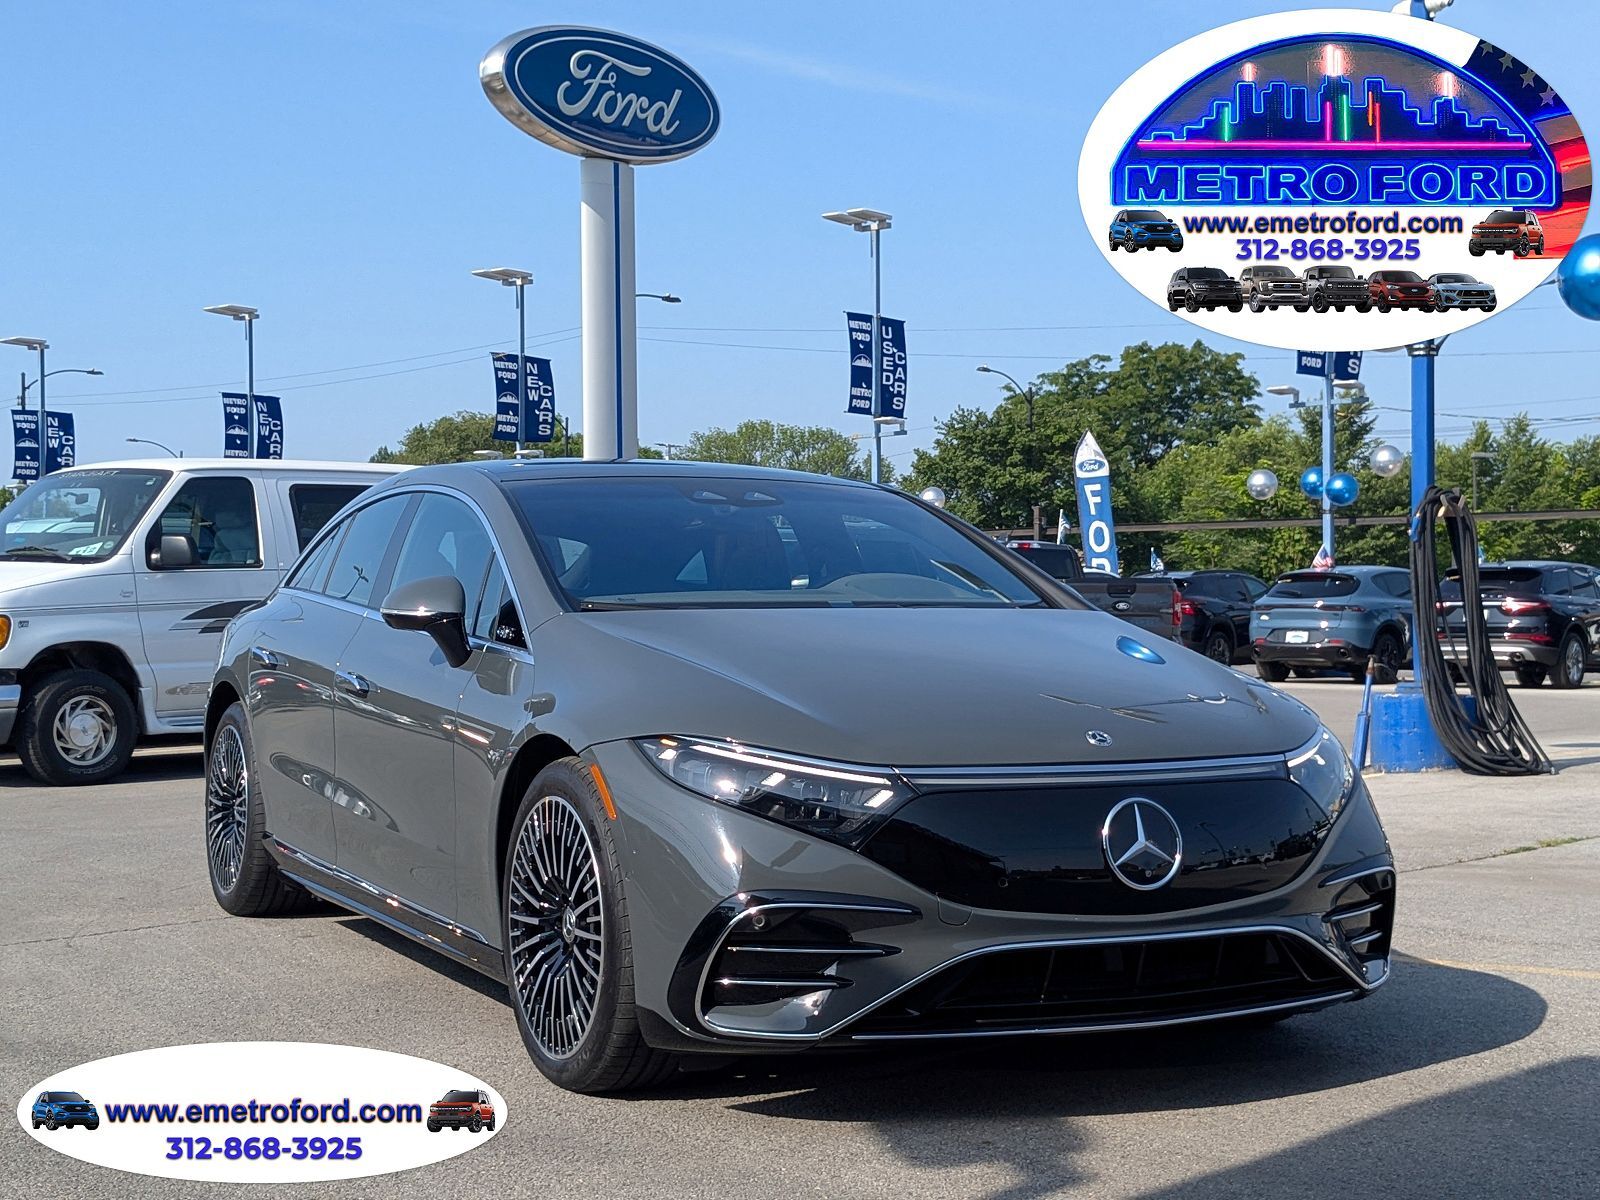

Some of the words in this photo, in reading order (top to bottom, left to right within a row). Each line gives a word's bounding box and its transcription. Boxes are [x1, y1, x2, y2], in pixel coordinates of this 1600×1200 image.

[557, 50, 682, 136] Ford
[849, 320, 872, 331] METRO
[852, 332, 871, 342] FORD
[494, 361, 518, 370] METRO
[1301, 356, 1322, 368] FORD
[882, 325, 894, 385] USED
[892, 351, 906, 410] CARS
[497, 371, 517, 380] FORD
[851, 387, 872, 397] METRO
[223, 398, 247, 406] METRO
[526, 362, 540, 401] NEW
[538, 385, 553, 435] CARS
[851, 399, 871, 409] FORD
[13, 414, 38, 422] METRO
[256, 401, 269, 436] NEW
[496, 413, 519, 423] METRO
[47, 417, 60, 448] NEW
[497, 424, 517, 433] FORD
